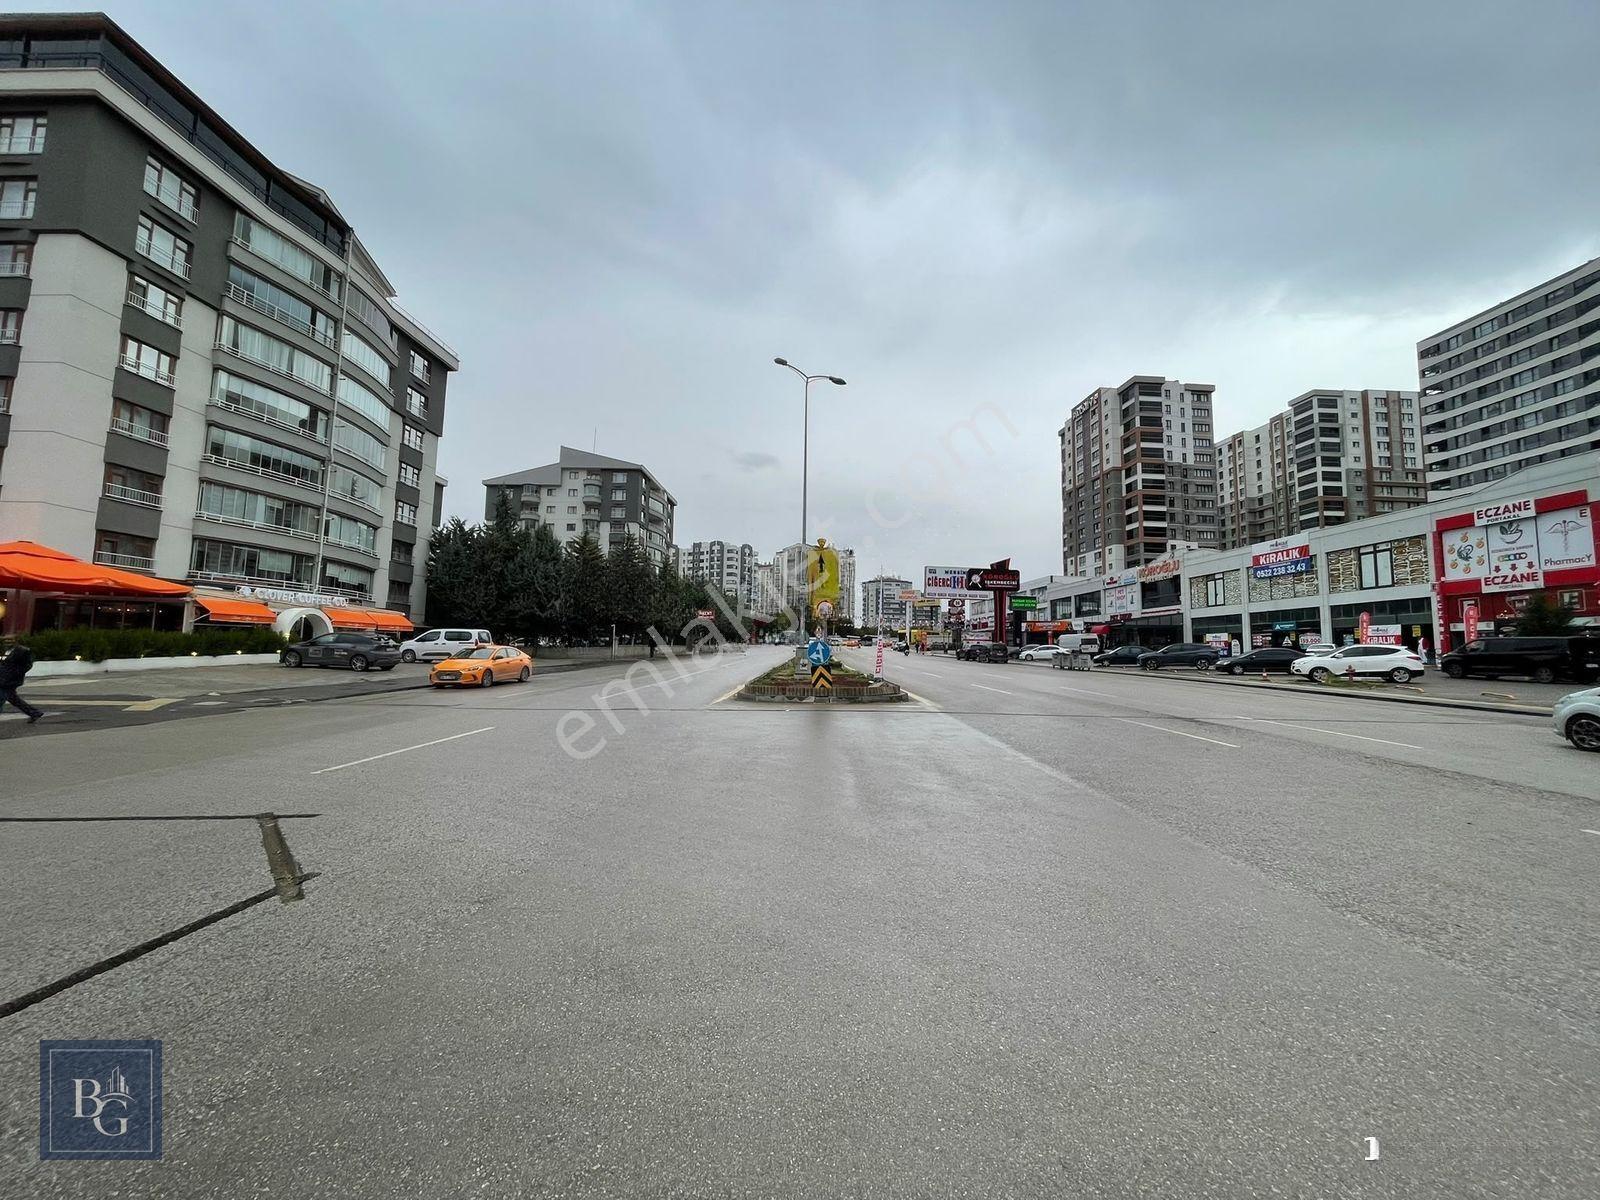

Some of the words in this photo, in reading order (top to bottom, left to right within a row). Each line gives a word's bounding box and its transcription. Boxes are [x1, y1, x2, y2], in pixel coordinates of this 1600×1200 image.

[1476, 500, 1531, 519] ECZANE
[1486, 513, 1521, 523] PORTAKAL
[1484, 572, 1540, 586] ECZANE
